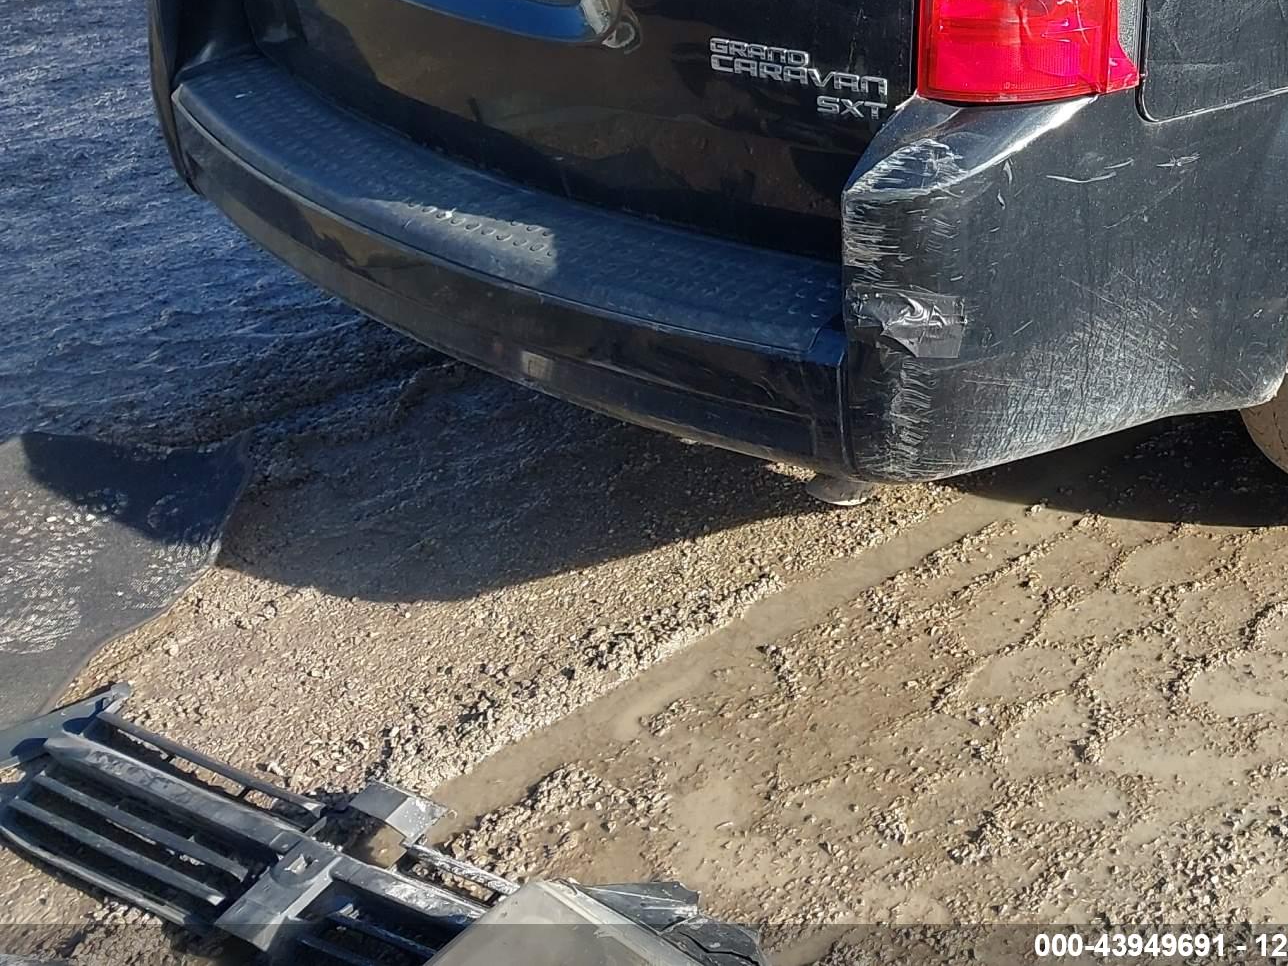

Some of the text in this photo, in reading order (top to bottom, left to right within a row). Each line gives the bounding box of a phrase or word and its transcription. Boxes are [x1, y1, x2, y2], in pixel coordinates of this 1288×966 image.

[710, 37, 809, 67] GRAND
[710, 54, 888, 96] CARAVAN
[816, 95, 888, 120] SXT
